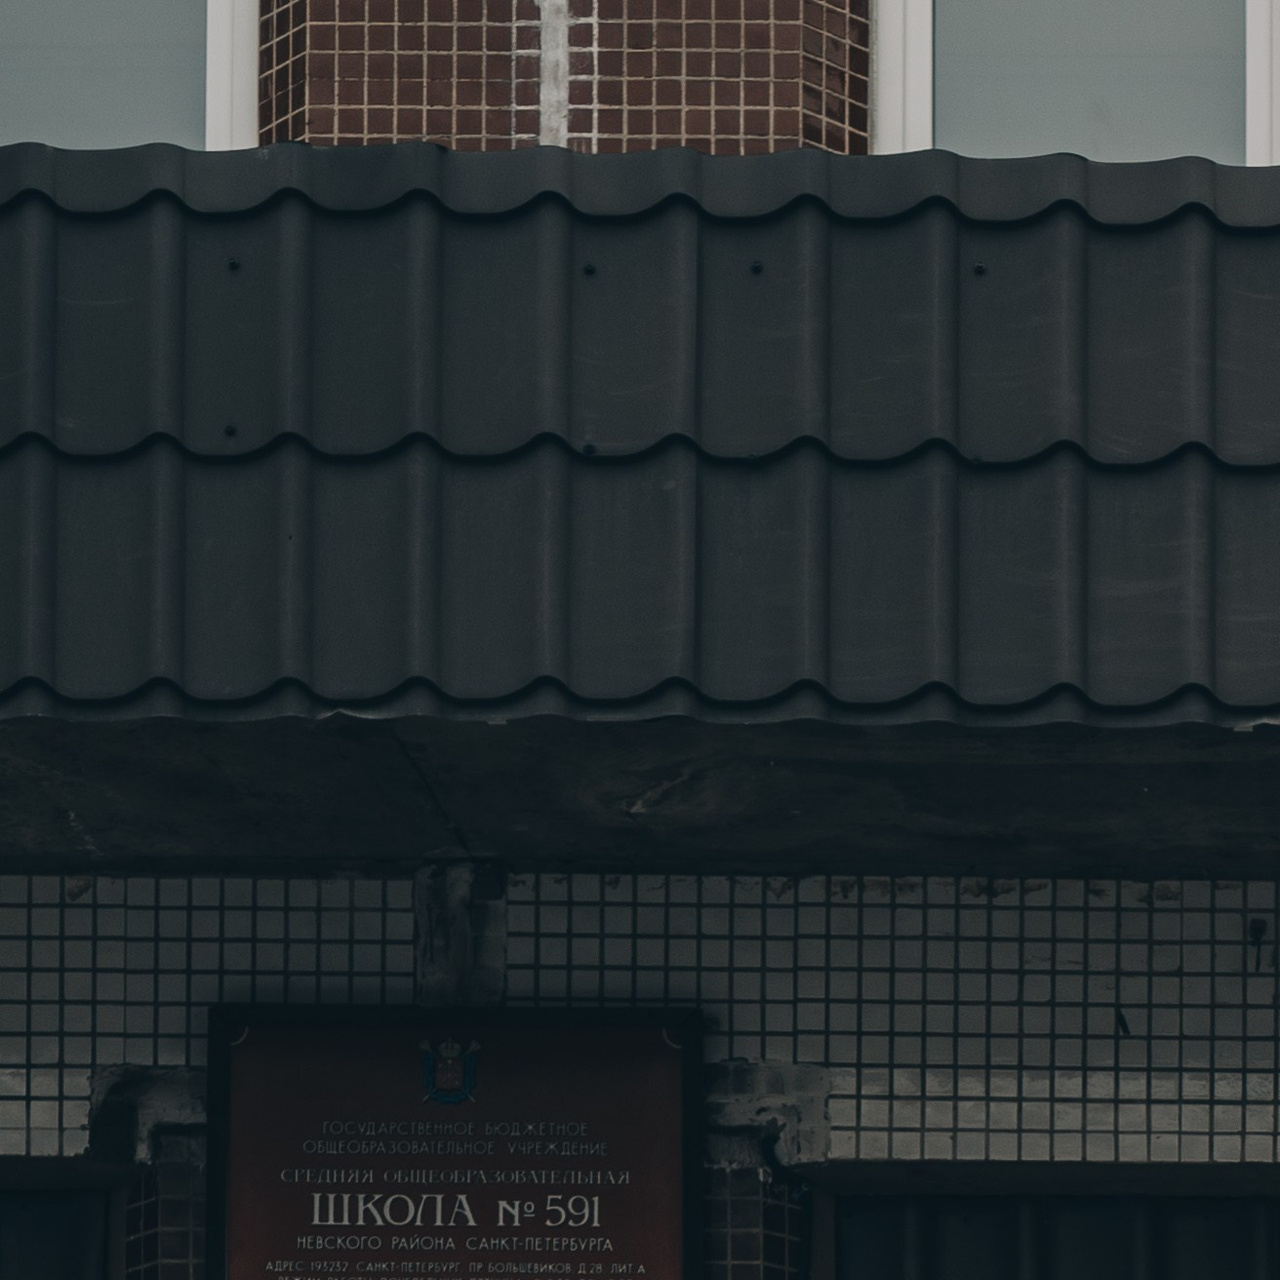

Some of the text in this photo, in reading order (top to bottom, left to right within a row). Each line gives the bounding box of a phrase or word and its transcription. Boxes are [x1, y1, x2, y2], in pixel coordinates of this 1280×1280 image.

[322, 1120, 588, 1137] ГОСУДАРСТВЕННОЕ БЮДЖЕТНОЕ
[302, 1138, 607, 1156] ОБЩЕОБРАЗОВАТЕЛЬНОЕ УЧРЕЖДЕНИЕ
[280, 1168, 631, 1185] СРЕДНЯЯ ОБЩЕОБРАЗОВАТЕЛЬНАЯ
[311, 1193, 601, 1226] ШКОЛА № 591
[297, 1233, 614, 1252] НЕВСКОГО РАЙОНА САНКТ-ПЕТЕРБУРГА
